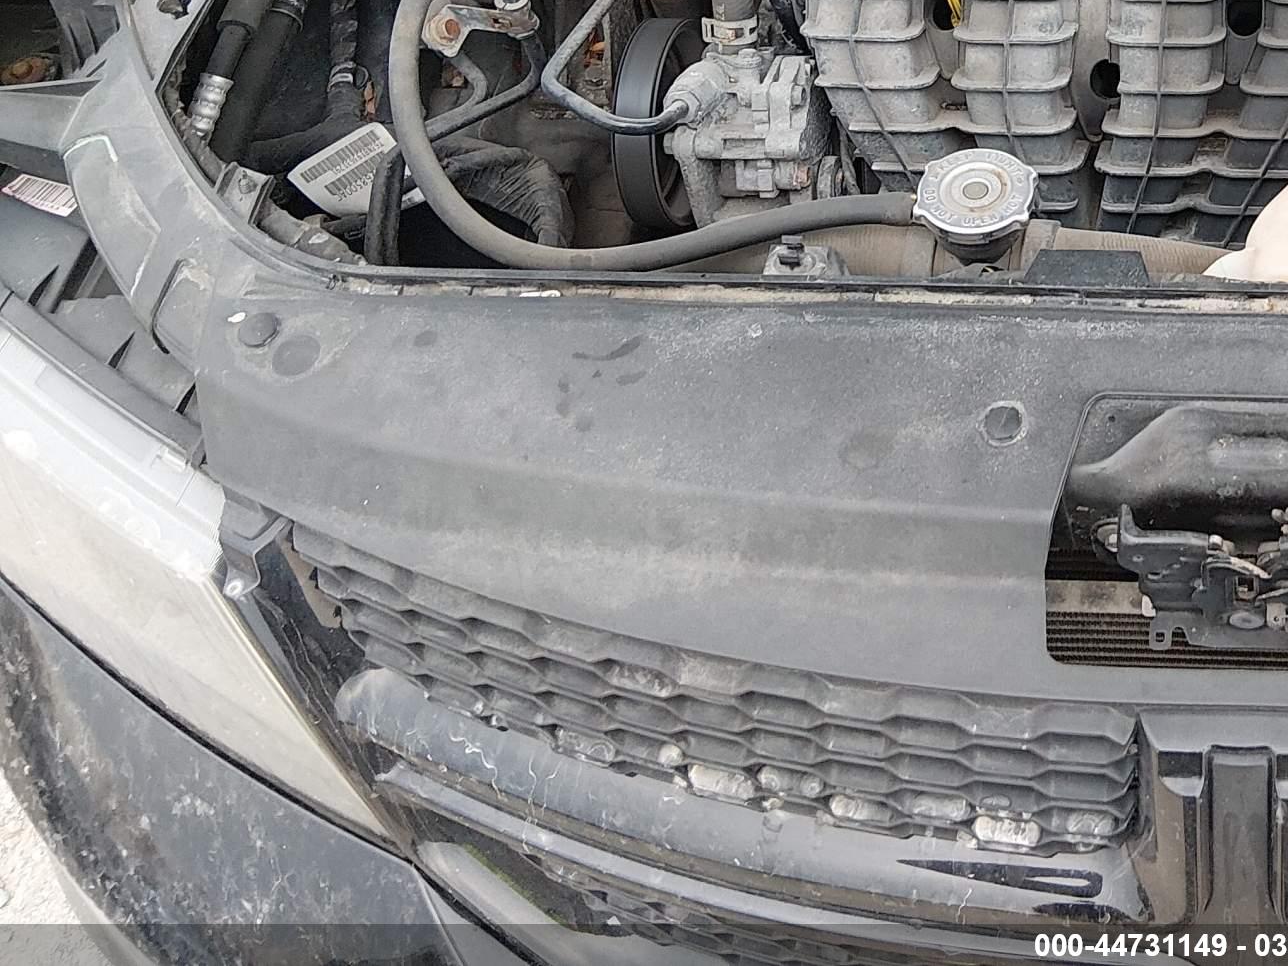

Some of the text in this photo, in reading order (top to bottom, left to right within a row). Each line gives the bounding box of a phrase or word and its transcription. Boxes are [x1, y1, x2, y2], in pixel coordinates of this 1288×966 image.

[938, 150, 1024, 177] KEEP TIGHT
[923, 188, 1022, 226] DO NOT OPEN HOT
